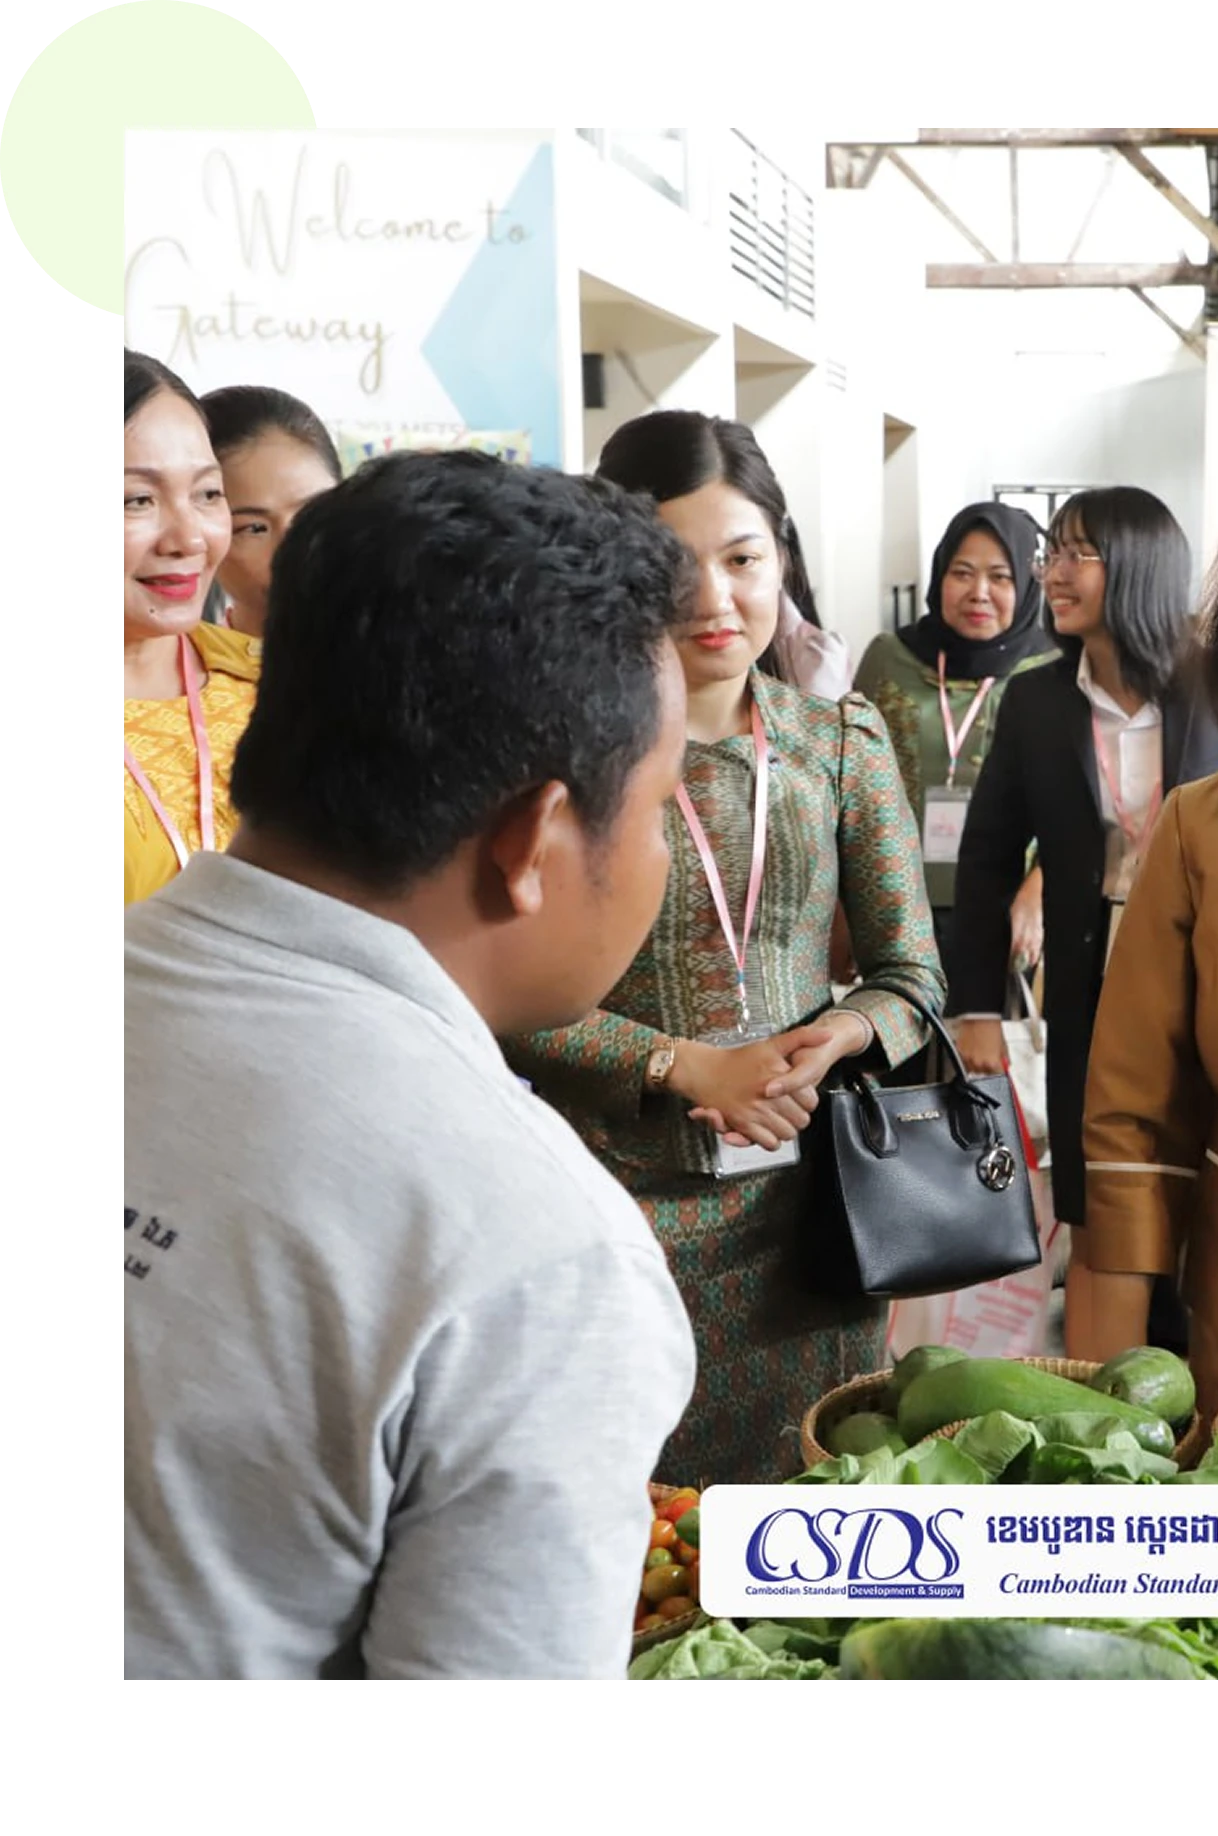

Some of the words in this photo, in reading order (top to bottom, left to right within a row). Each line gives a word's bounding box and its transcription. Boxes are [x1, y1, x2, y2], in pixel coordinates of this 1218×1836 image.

[202, 144, 472, 276] Welcome
[479, 199, 532, 246] to
[124, 236, 395, 395] Gateway
